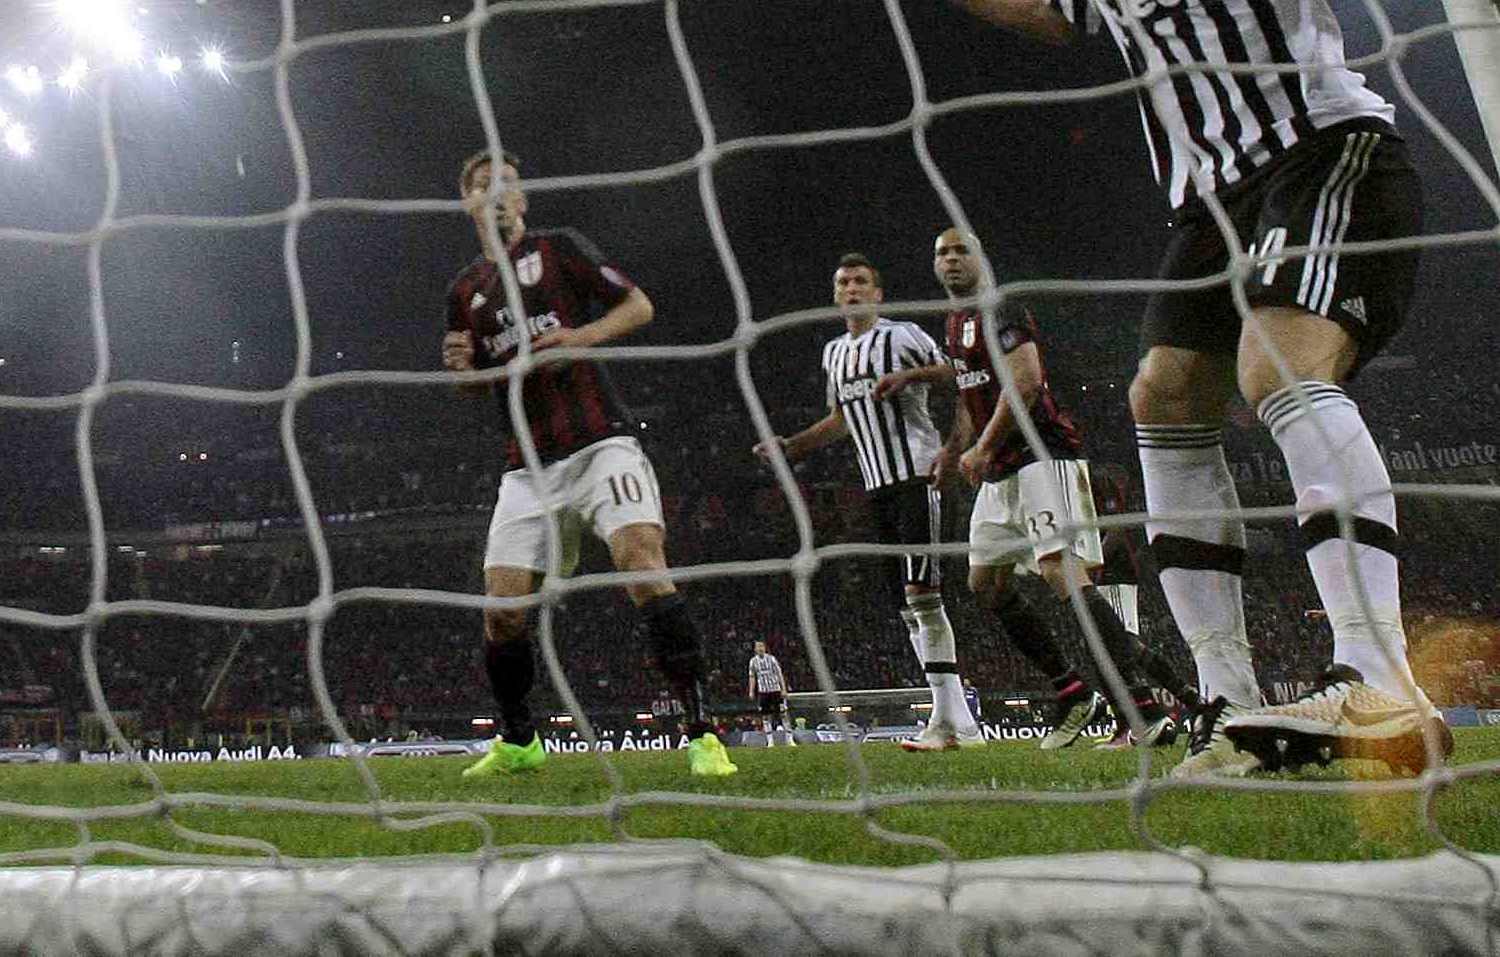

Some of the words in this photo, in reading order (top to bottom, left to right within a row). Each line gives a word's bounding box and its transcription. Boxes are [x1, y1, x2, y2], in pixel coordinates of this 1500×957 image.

[605, 472, 643, 506] 10
[620, 734, 671, 752] Audi
[147, 748, 212, 763] Nuova
[216, 745, 263, 762] Audi
